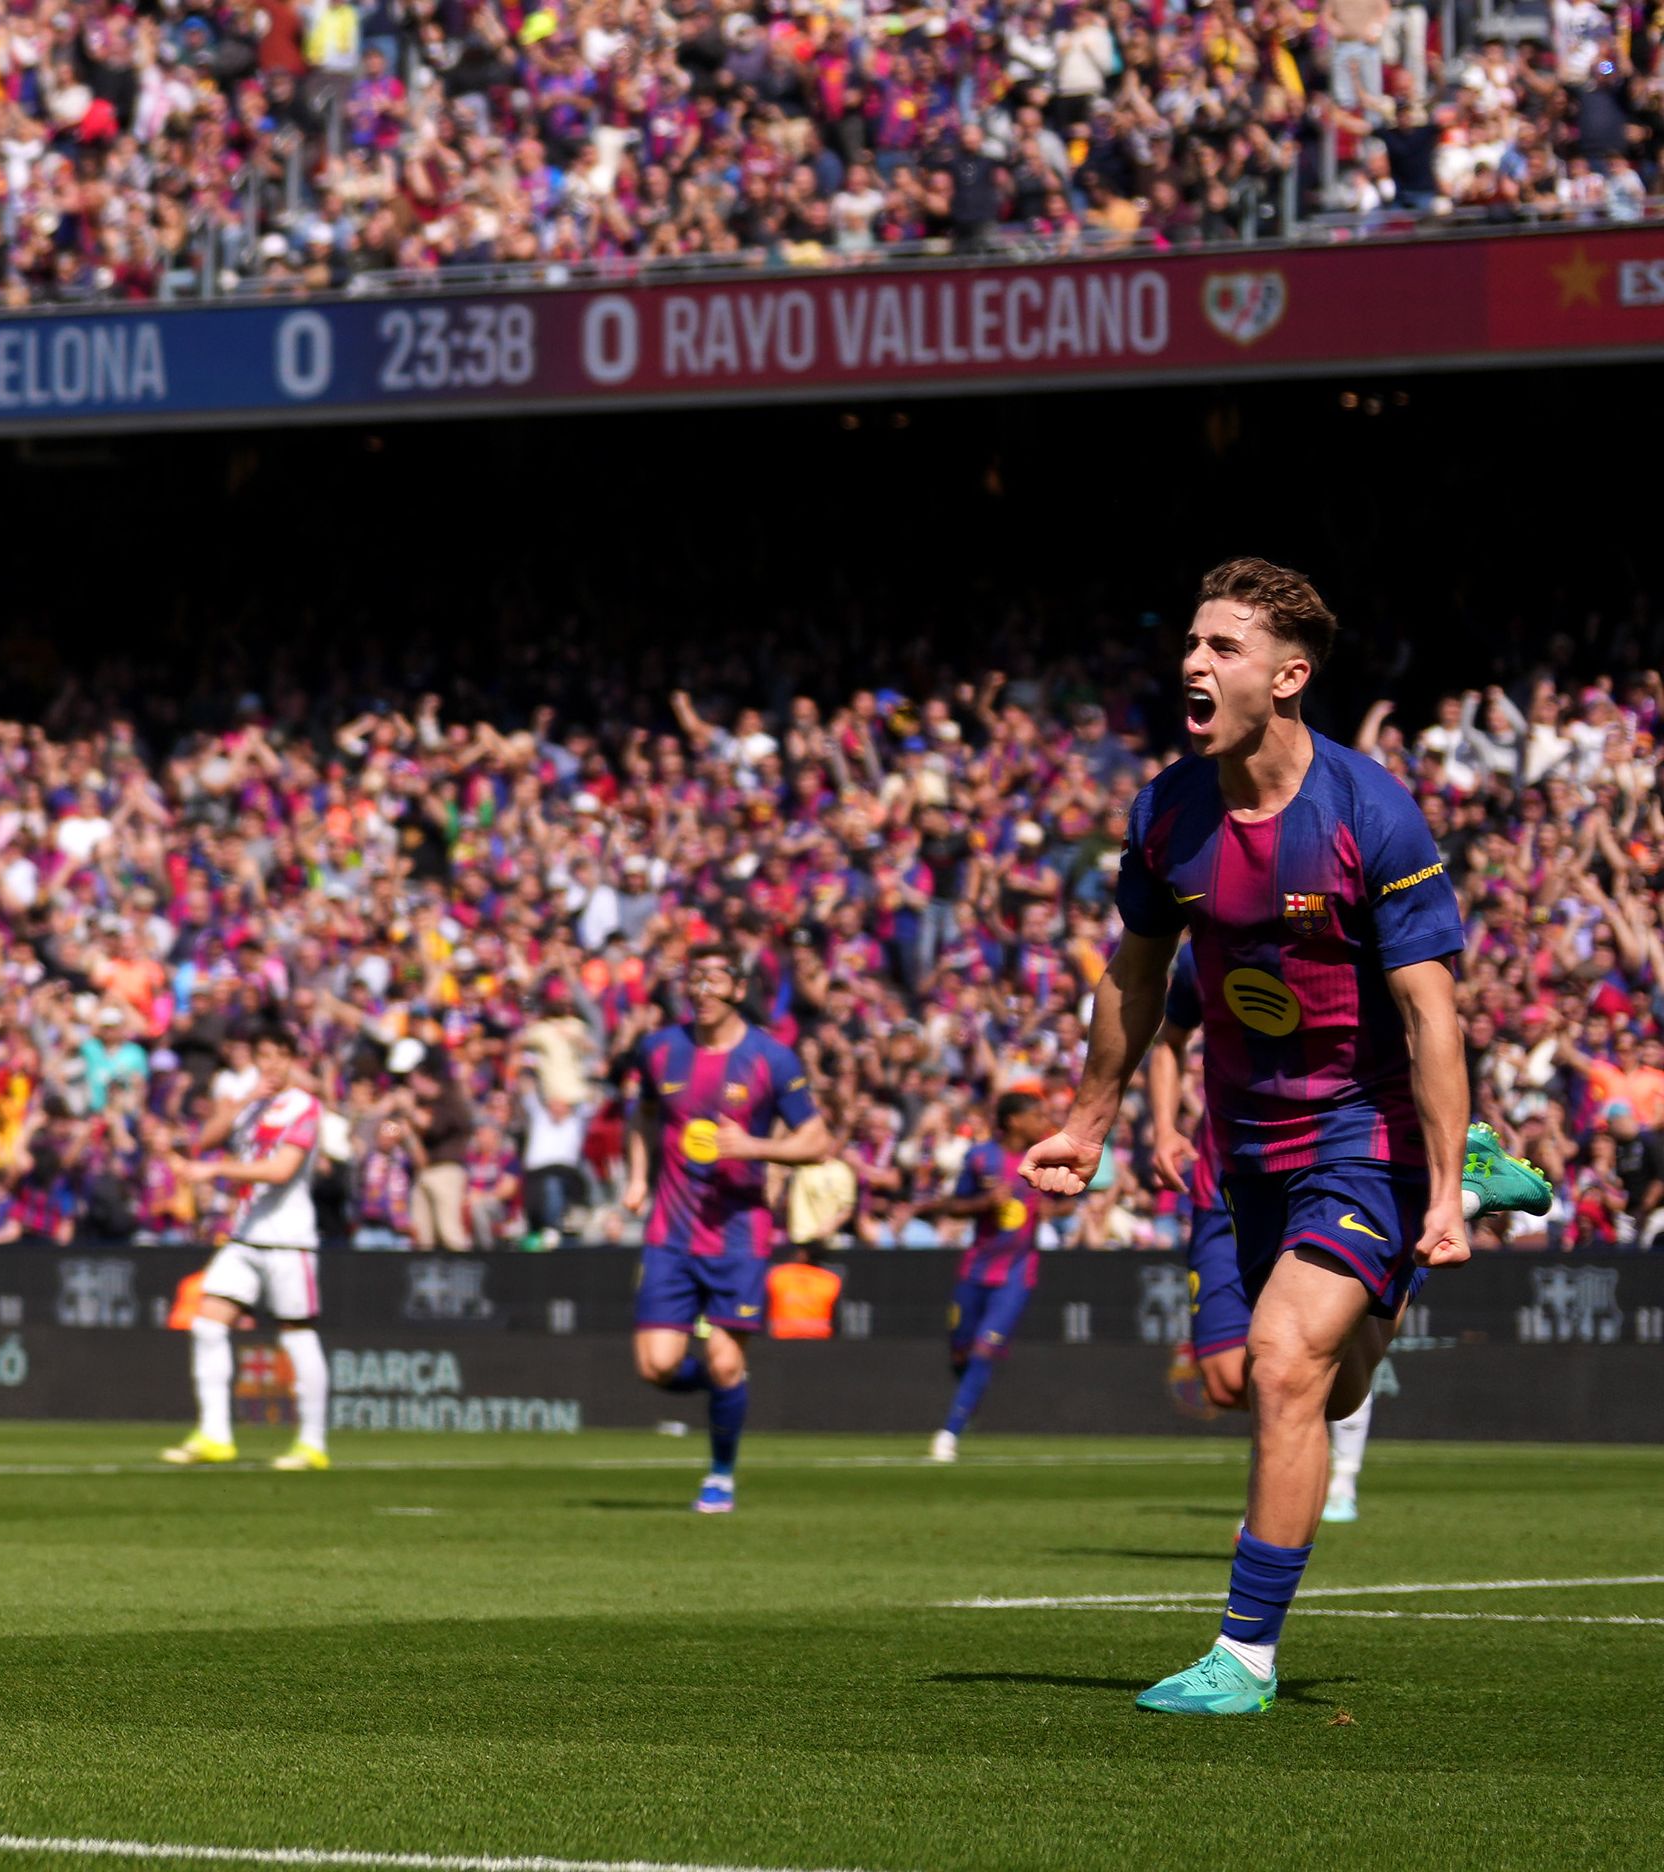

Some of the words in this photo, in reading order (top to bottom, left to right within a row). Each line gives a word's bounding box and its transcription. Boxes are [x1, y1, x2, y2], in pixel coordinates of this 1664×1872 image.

[276, 310, 331, 398] 0
[378, 304, 534, 390] 23:38
[582, 294, 639, 383] 0
[663, 290, 816, 377] RAYO
[830, 272, 1168, 368] VALLECANO
[1382, 863, 1444, 895] AMBILIGHT
[332, 1349, 462, 1395] BARÇA
[332, 1395, 581, 1433] FOUNDATION
